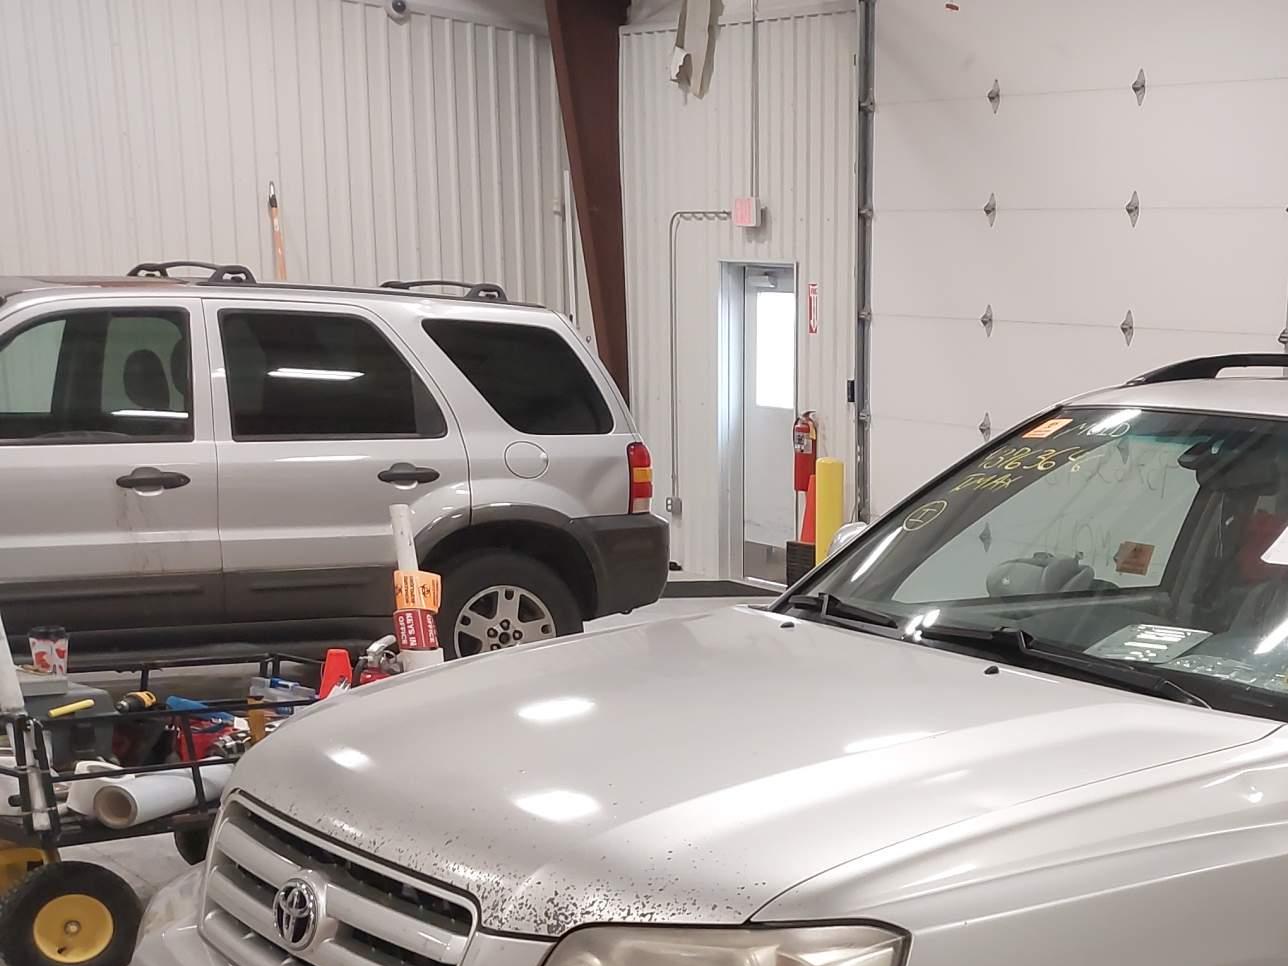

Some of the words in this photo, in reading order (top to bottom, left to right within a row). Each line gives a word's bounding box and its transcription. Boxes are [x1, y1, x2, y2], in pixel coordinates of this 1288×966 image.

[398, 615, 408, 645] OFFICE
[405, 613, 416, 637] KEYS
[409, 636, 417, 647] IN
